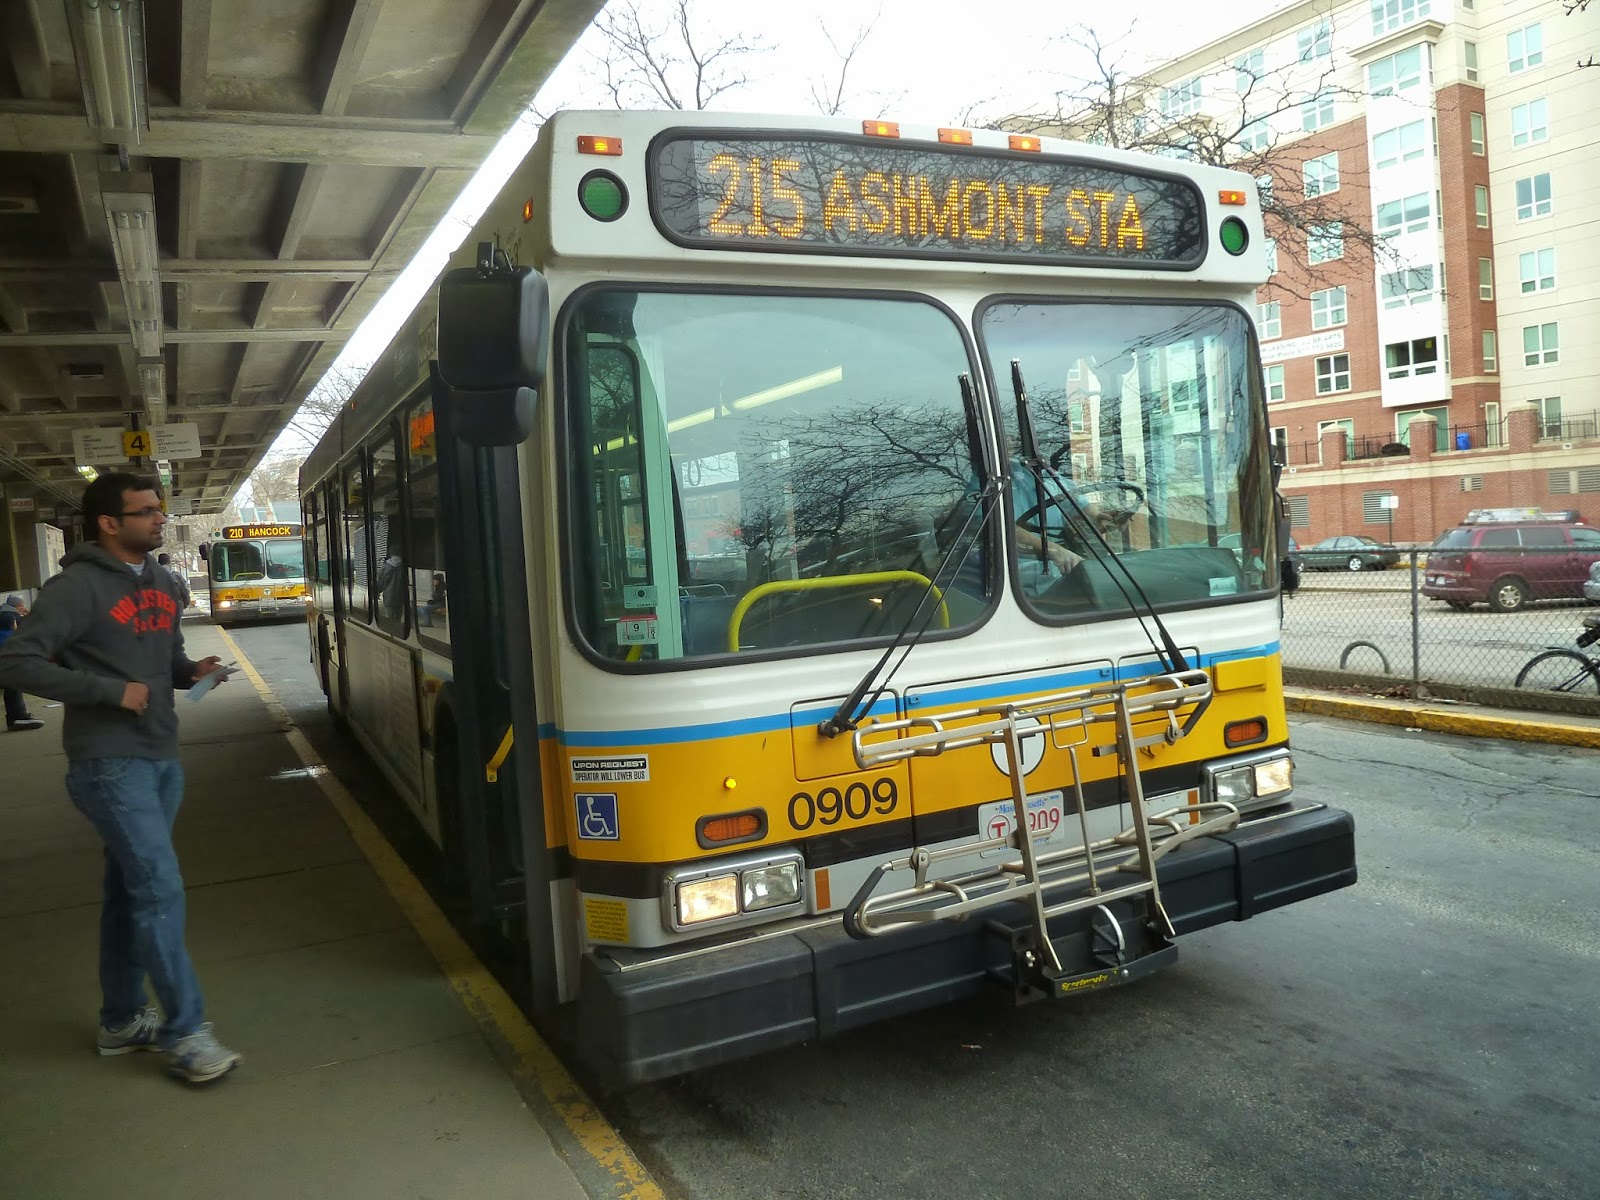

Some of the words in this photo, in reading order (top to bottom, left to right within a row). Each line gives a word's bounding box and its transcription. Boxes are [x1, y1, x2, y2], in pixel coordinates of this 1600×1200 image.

[708, 154, 804, 237] 215
[823, 168, 1050, 244] ASHMONT
[1065, 188, 1145, 250] STA
[130, 435, 146, 452] 4
[229, 528, 244, 538] 210
[249, 526, 292, 537] HANCOCK
[633, 623, 640, 632] 9
[600, 760, 645, 768] REQUEST
[575, 772, 600, 781] OPERATOR
[601, 771, 614, 781] WILL
[614, 771, 633, 780] LOWER
[633, 770, 646, 780] BUS
[787, 777, 899, 831] 0909
[991, 821, 1007, 838] T
